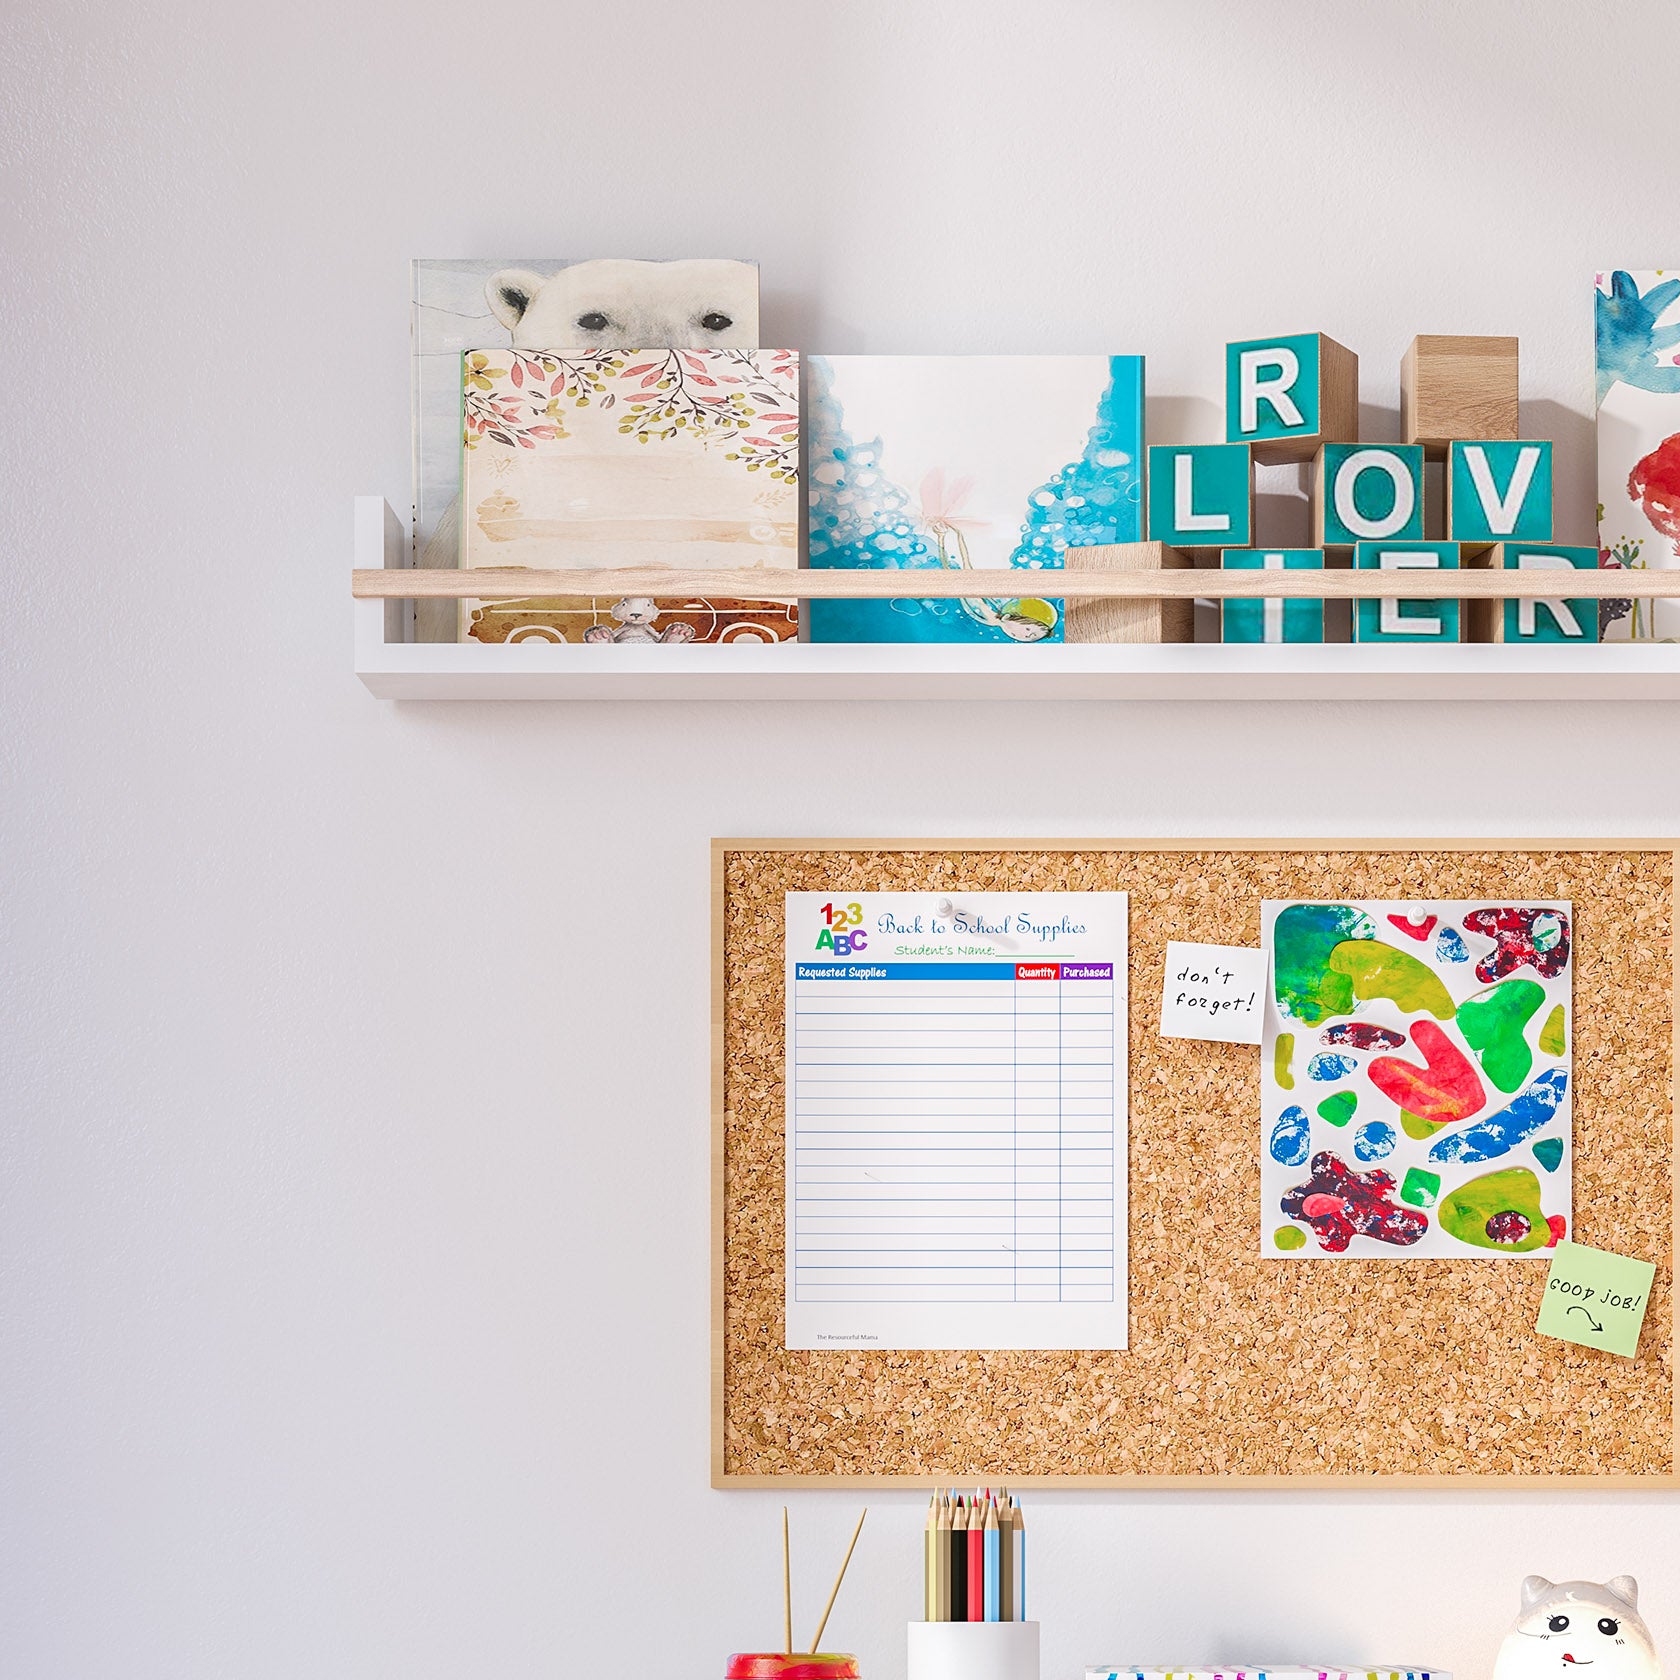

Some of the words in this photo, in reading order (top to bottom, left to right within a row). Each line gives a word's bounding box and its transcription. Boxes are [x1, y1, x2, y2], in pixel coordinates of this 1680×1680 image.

[1240, 347, 1304, 433] R
[1174, 454, 1230, 532] L
[1463, 446, 1541, 535] V
[820, 902, 863, 931] 123
[877, 913, 924, 934] Back
[931, 919, 945, 934] to
[953, 912, 1011, 934] School
[1016, 912, 1087, 942] Supplies
[815, 928, 868, 956] ABC
[894, 946, 954, 956] Student's
[957, 946, 995, 956] Name:
[798, 967, 846, 980] Requested
[848, 967, 887, 980] Supplies
[1018, 967, 1056, 980] Quantity
[1063, 967, 1111, 978] Purchased
[1177, 967, 1234, 984] don't
